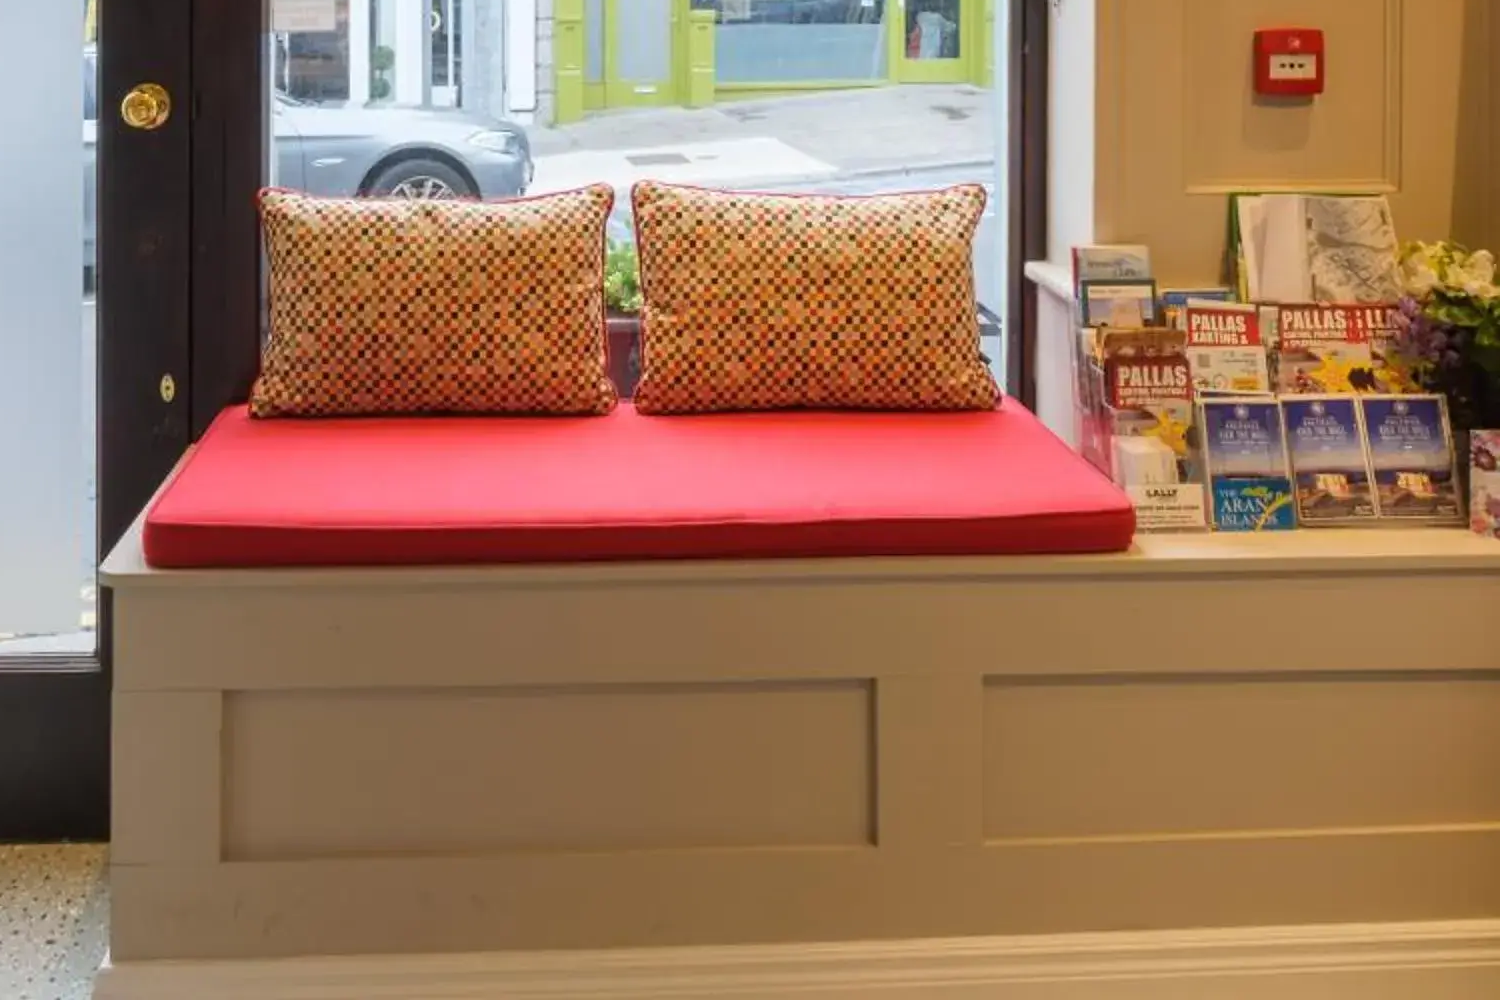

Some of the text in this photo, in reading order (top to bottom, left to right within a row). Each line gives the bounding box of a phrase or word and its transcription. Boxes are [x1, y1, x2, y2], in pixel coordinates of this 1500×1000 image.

[1191, 312, 1247, 333] PALLAS
[1282, 308, 1347, 330] PALLAS
[1117, 364, 1187, 387] PALLAS
